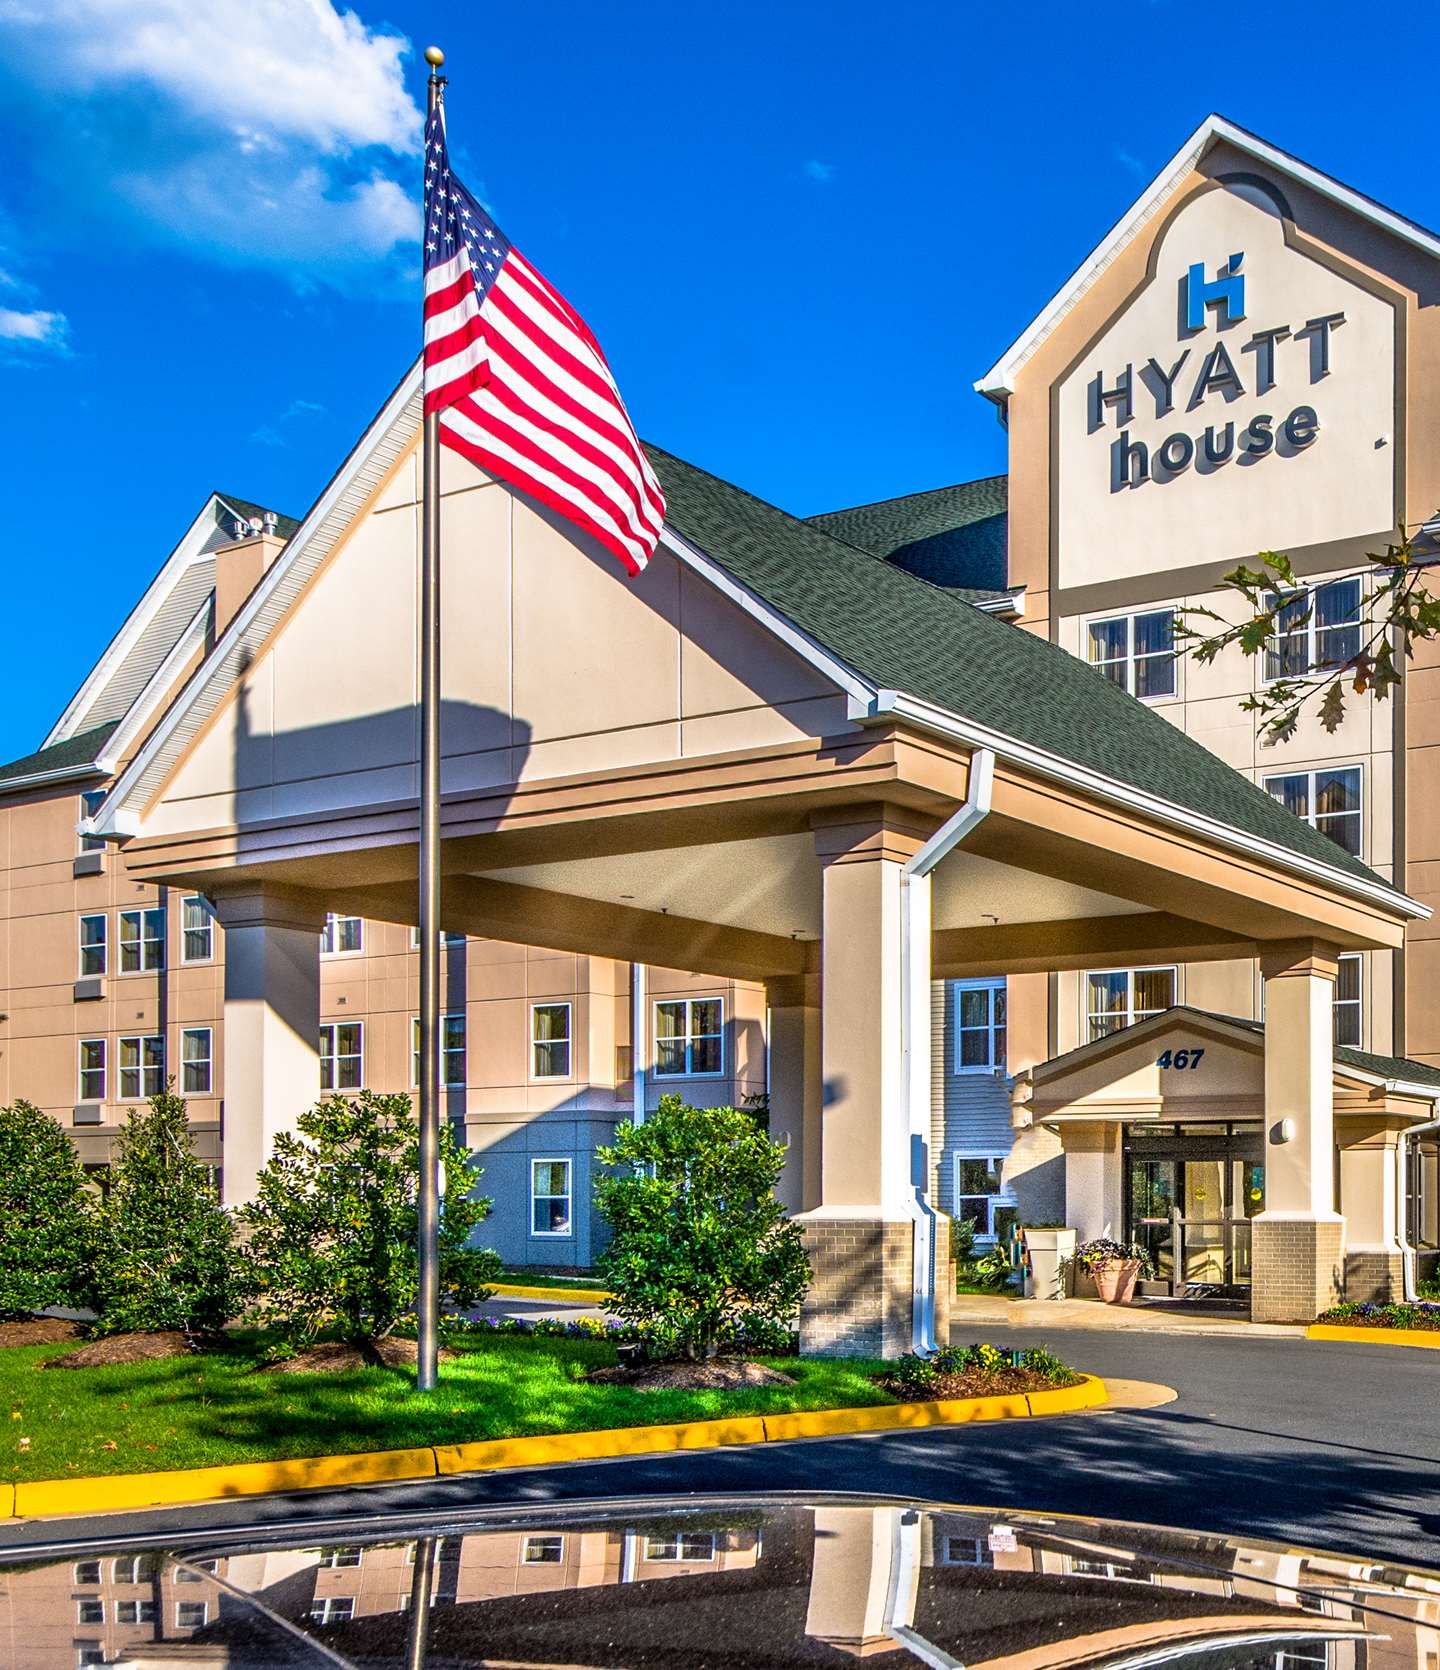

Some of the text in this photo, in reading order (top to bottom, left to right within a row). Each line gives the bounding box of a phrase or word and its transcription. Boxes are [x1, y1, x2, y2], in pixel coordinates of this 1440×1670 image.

[1093, 311, 1346, 426] HYATT
[1117, 405, 1319, 485] house
[1156, 1048, 1205, 1070] 467
